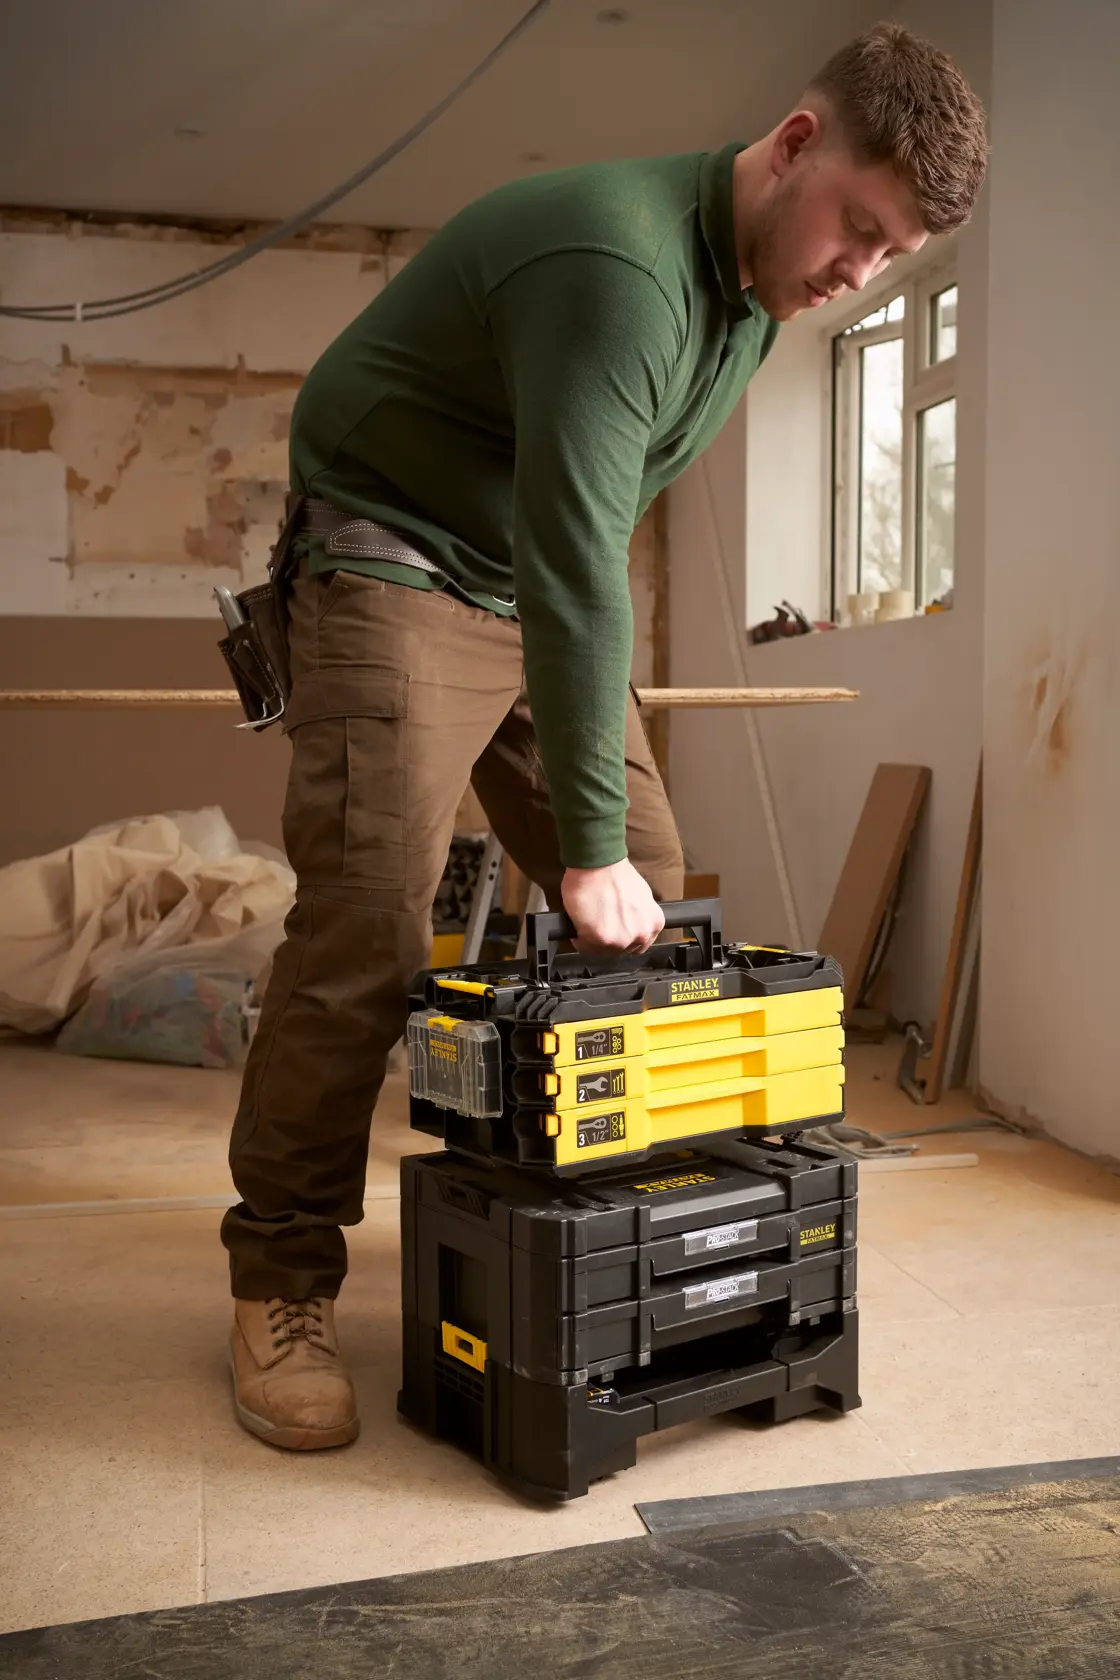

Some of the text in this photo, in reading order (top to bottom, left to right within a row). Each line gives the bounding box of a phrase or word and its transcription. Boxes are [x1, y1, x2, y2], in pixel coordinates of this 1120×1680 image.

[671, 977, 719, 993] STANLEY
[676, 990, 715, 1001] FATMAX
[430, 1047, 457, 1062] STANLEY
[577, 1046, 583, 1059] 1
[578, 1089, 586, 1102] 2
[578, 1133, 586, 1146] 3
[800, 1223, 836, 1240] STANLEY
